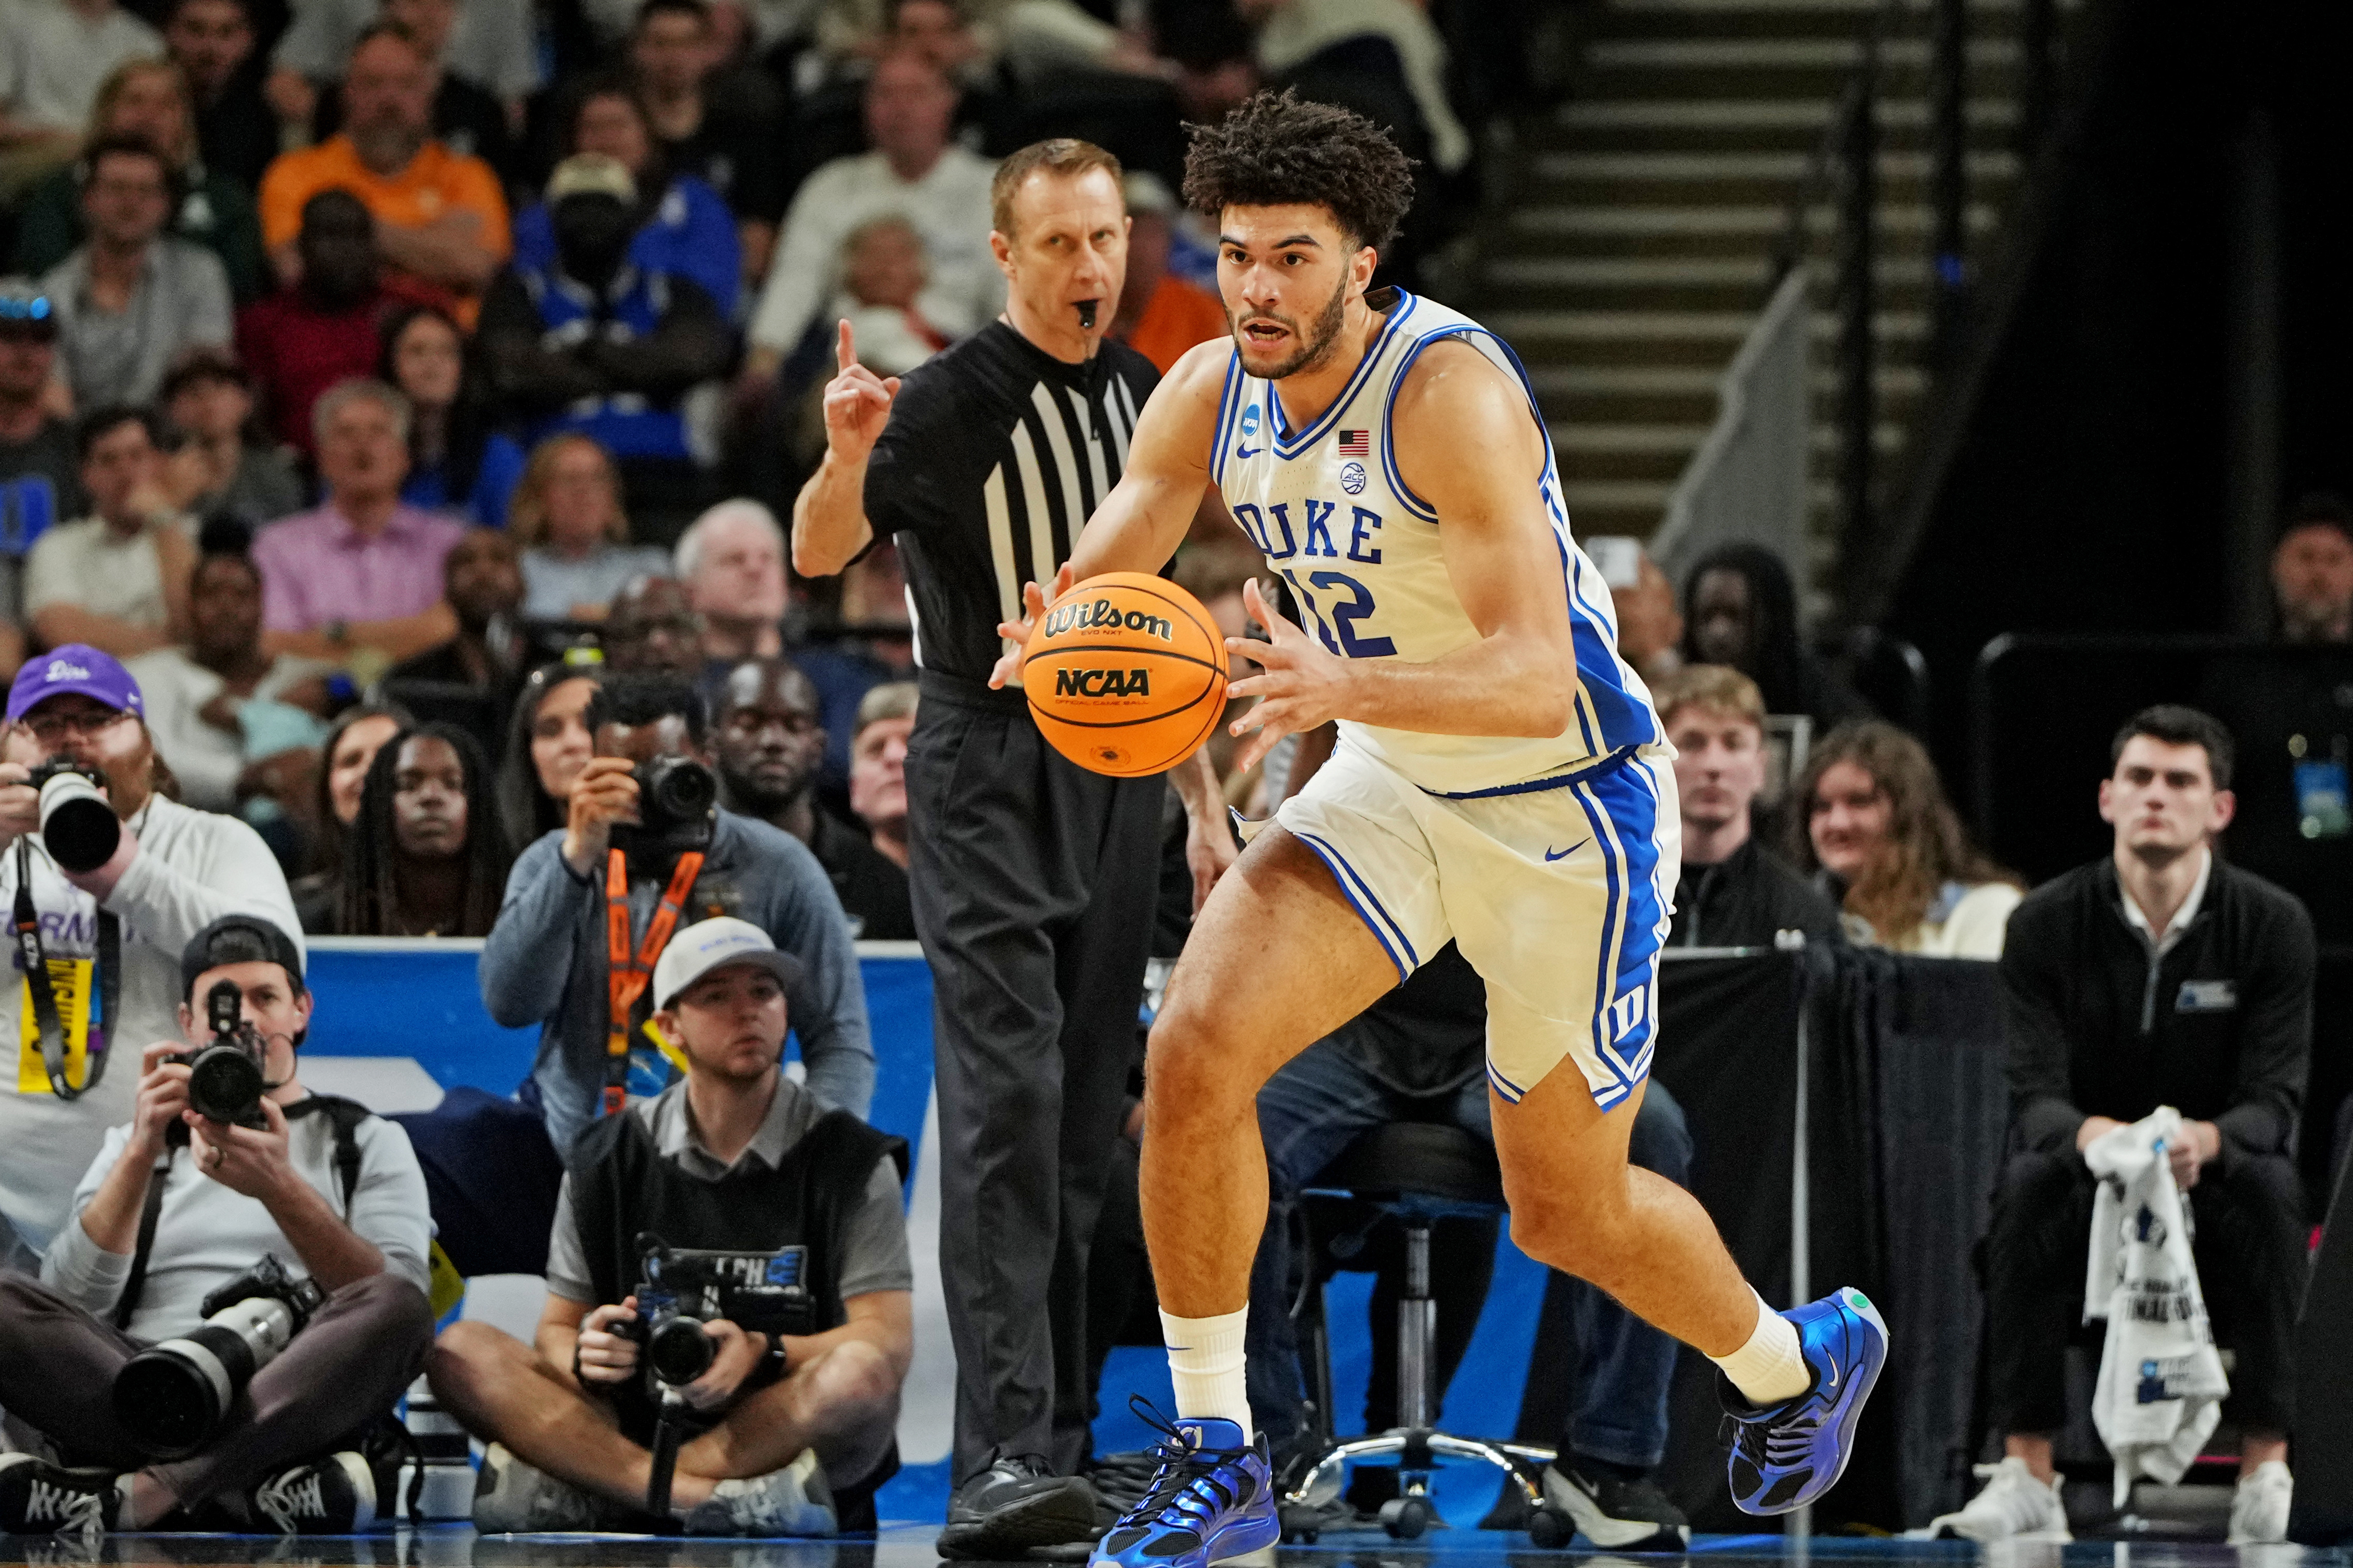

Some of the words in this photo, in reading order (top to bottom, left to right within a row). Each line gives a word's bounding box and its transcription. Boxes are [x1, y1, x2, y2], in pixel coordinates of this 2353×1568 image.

[1233, 499, 1382, 564] DUKE
[1044, 599, 1172, 642] Wilson
[1282, 569, 1398, 658] 12
[1055, 667, 1150, 698] NCAA
[1612, 985, 1644, 1043] D
